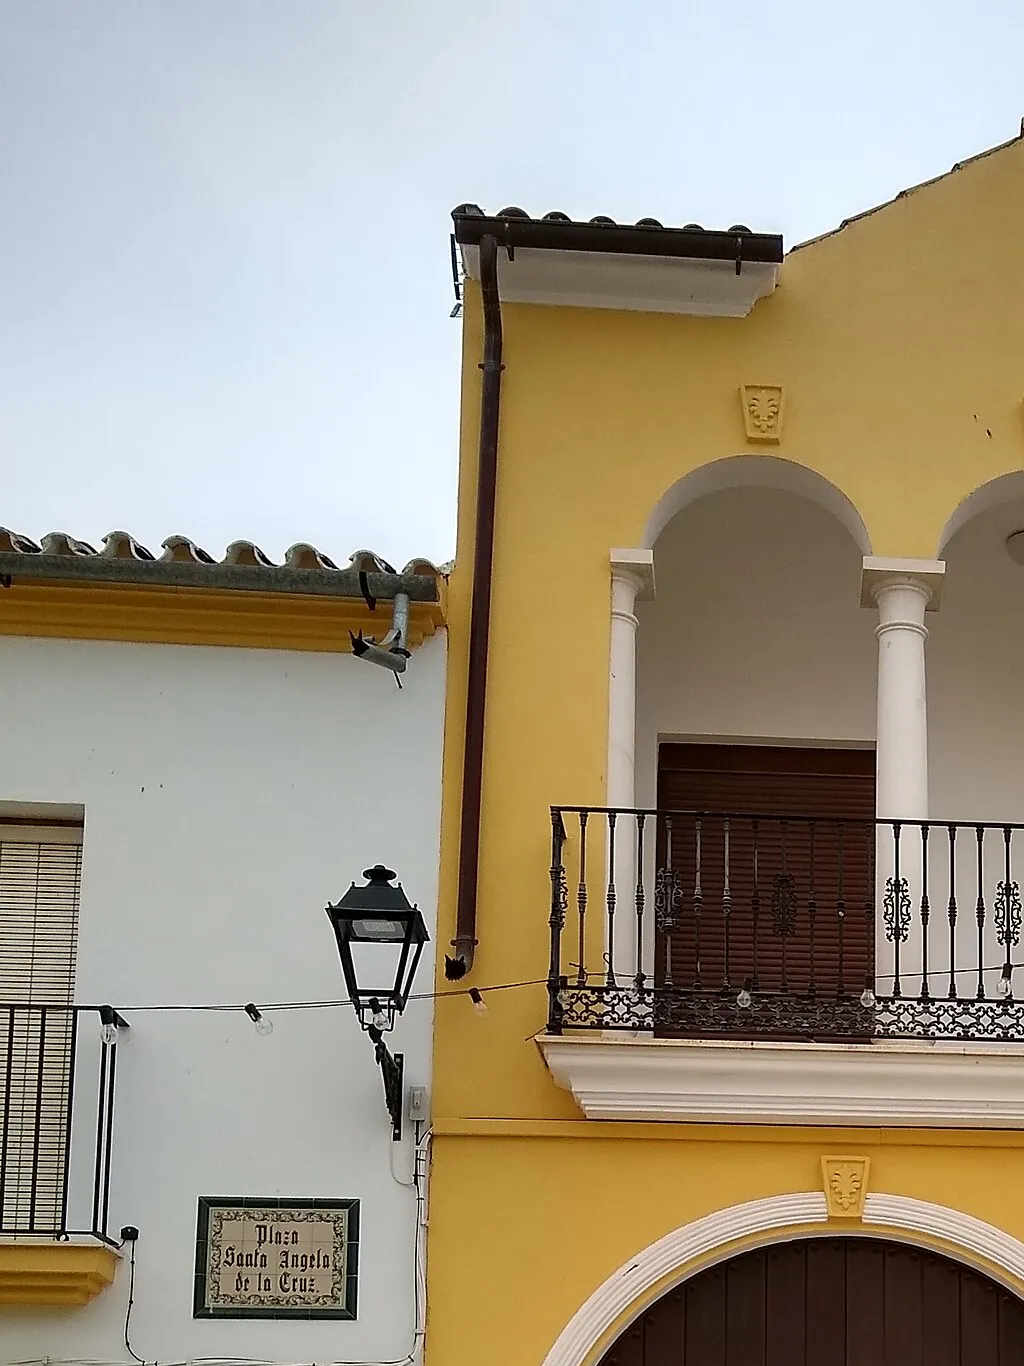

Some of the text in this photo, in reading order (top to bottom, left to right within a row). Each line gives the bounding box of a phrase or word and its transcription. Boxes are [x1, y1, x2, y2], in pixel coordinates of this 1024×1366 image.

[255, 1225, 299, 1247] Plaza
[223, 1245, 330, 1272] Santa Angela
[235, 1271, 320, 1293] de la Cruz.
